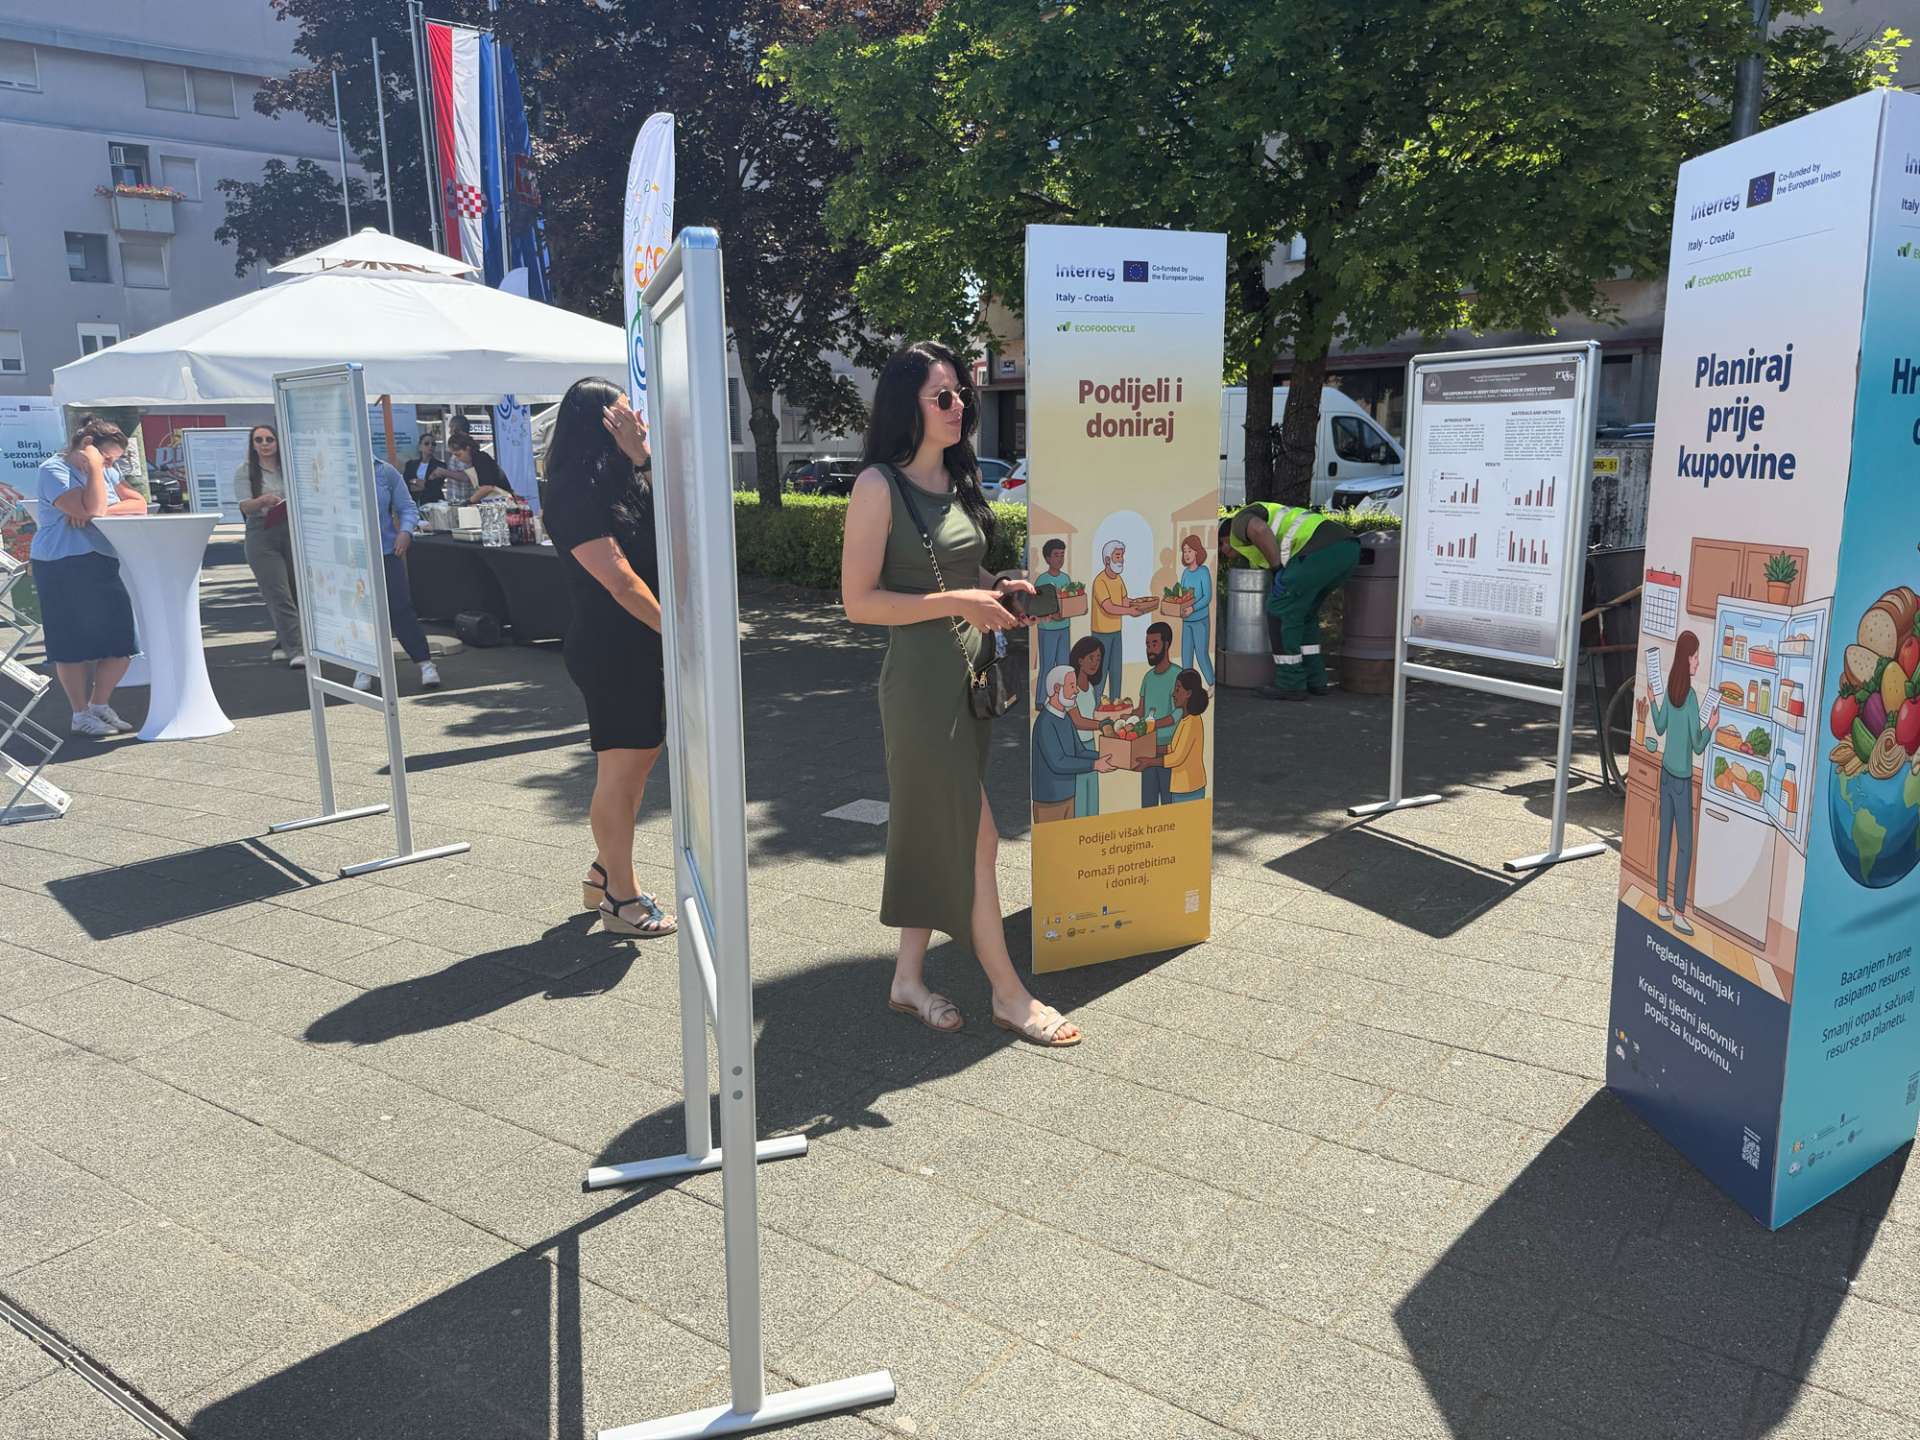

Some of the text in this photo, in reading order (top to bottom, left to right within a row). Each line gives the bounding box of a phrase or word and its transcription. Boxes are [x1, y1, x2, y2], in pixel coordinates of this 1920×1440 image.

[1776, 170, 1841, 195] the European Union
[1778, 163, 1821, 182] Co-funded by
[1690, 193, 1740, 221] Interreg
[1901, 198, 1919, 215] Italy
[1688, 239, 1703, 251] Italy
[1709, 230, 1735, 245] Croatia
[1056, 264, 1115, 281] Interreg
[1152, 265, 1181, 273] Co-funded
[1698, 267, 1752, 287] ECOFOODCYCLE
[1056, 293, 1075, 304] Italy
[1084, 294, 1114, 302] Croatia
[1075, 324, 1136, 333] ECOFOODCYCLE
[1695, 343, 1793, 392] Planiraj
[1079, 377, 1182, 411] Podijeli i
[1086, 411, 1174, 443] doniraj
[1706, 396, 1765, 443] prije
[4, 450, 53, 459] sezonsko
[17, 440, 42, 450] Biraj
[1678, 443, 1796, 488] kupovine
[1079, 822, 1175, 845] Podijeli višak hrane
[1109, 840, 1154, 854] drugima.
[1078, 856, 1176, 880] Pomaži potrebitima
[1106, 873, 1149, 888] i doniraj.
[1646, 935, 1741, 1005] Pregledaj hladnjak i
[1840, 946, 1912, 986] Bacanjem hrane
[1672, 974, 1707, 1005] ostavu.
[1834, 966, 1911, 1008] rasipamo resurse.
[1638, 976, 1744, 1060] Kreiraj tjedni jelovnik i
[1822, 985, 1915, 1043] Smanji otpad, sačuvaj
[1644, 1002, 1732, 1074] popis za kupovinu.
[1826, 1013, 1906, 1061] resurse za planetu.
